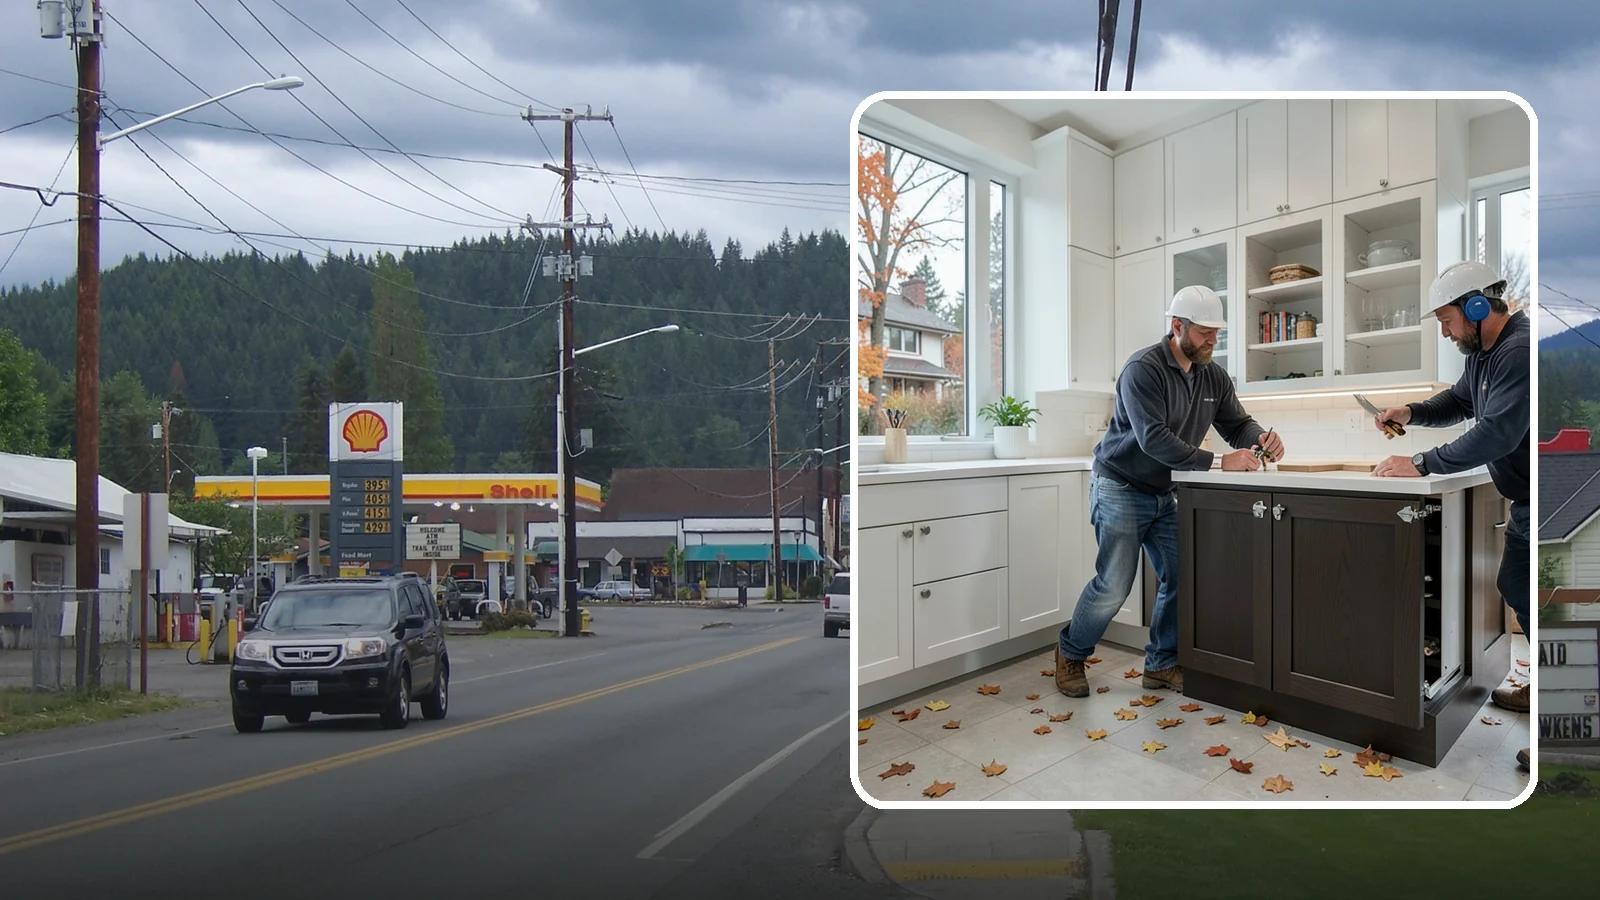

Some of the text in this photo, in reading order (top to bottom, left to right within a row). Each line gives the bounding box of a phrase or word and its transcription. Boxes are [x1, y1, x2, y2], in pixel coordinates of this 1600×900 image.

[366, 480, 383, 490] 395
[490, 484, 547, 498] Shell
[366, 494, 383, 504] 405
[366, 508, 383, 518] 415
[366, 522, 383, 532] 429
